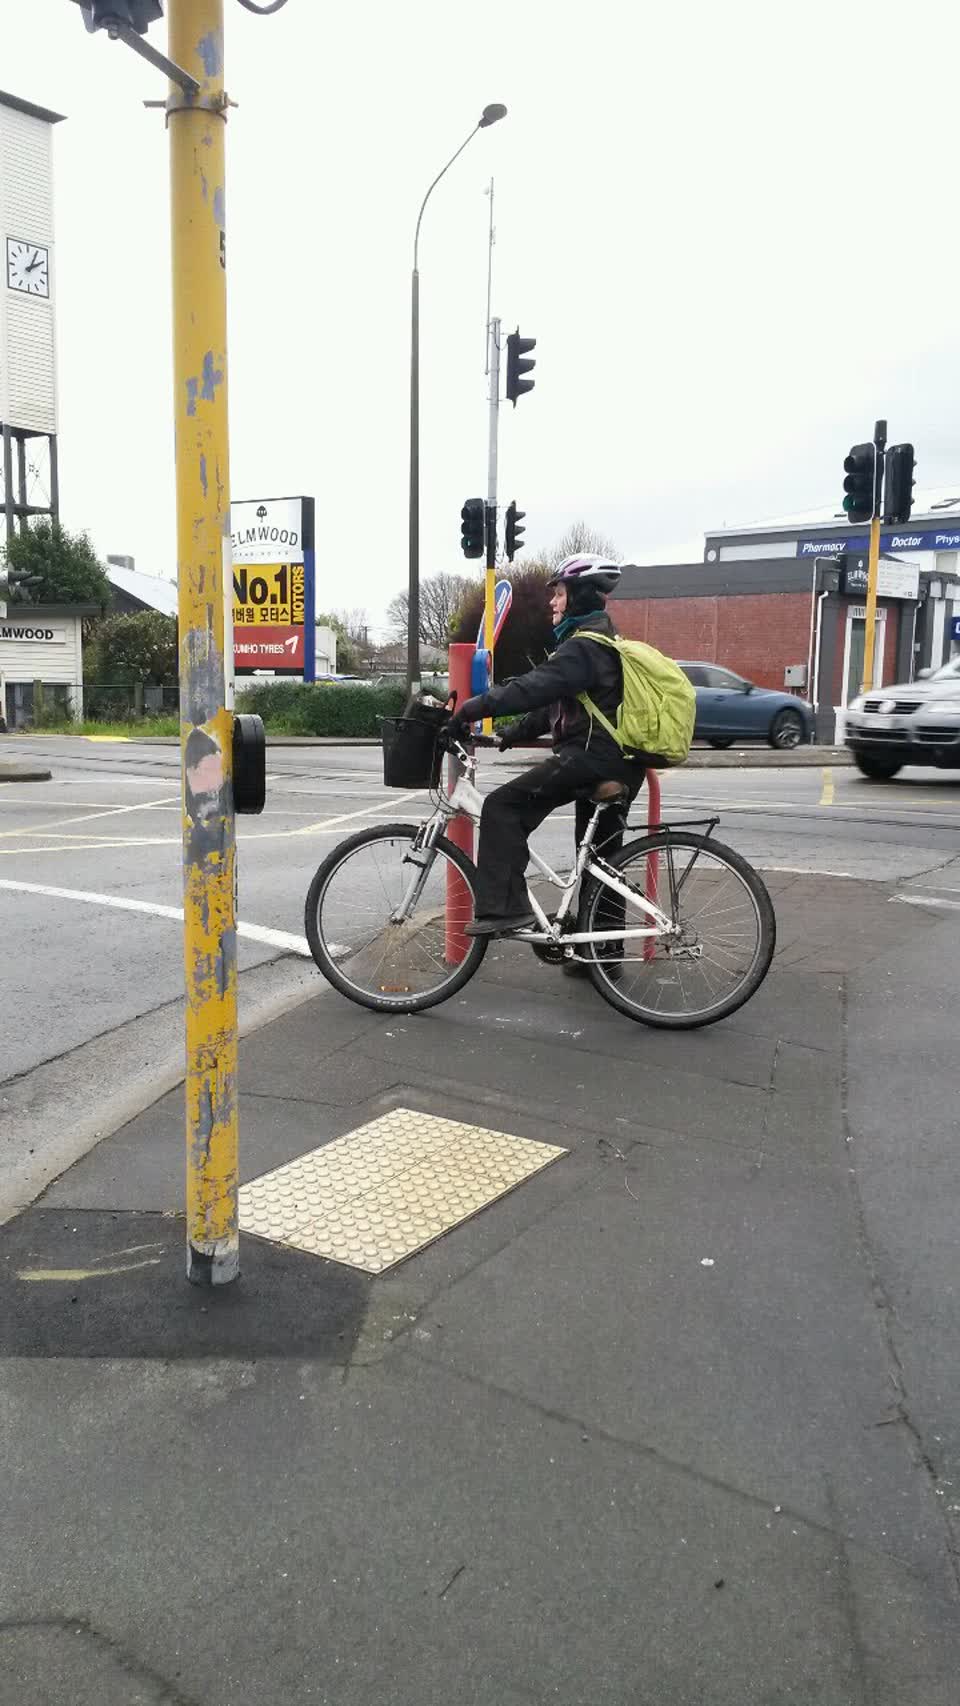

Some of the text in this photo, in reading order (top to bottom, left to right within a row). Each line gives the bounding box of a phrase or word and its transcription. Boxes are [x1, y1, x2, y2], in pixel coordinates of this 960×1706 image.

[891, 536, 923, 547] Doctor
[232, 565, 288, 606] No.1
[292, 566, 304, 623] MOTORS
[260, 607, 289, 622] 모터스
[259, 644, 285, 654] TYRES
